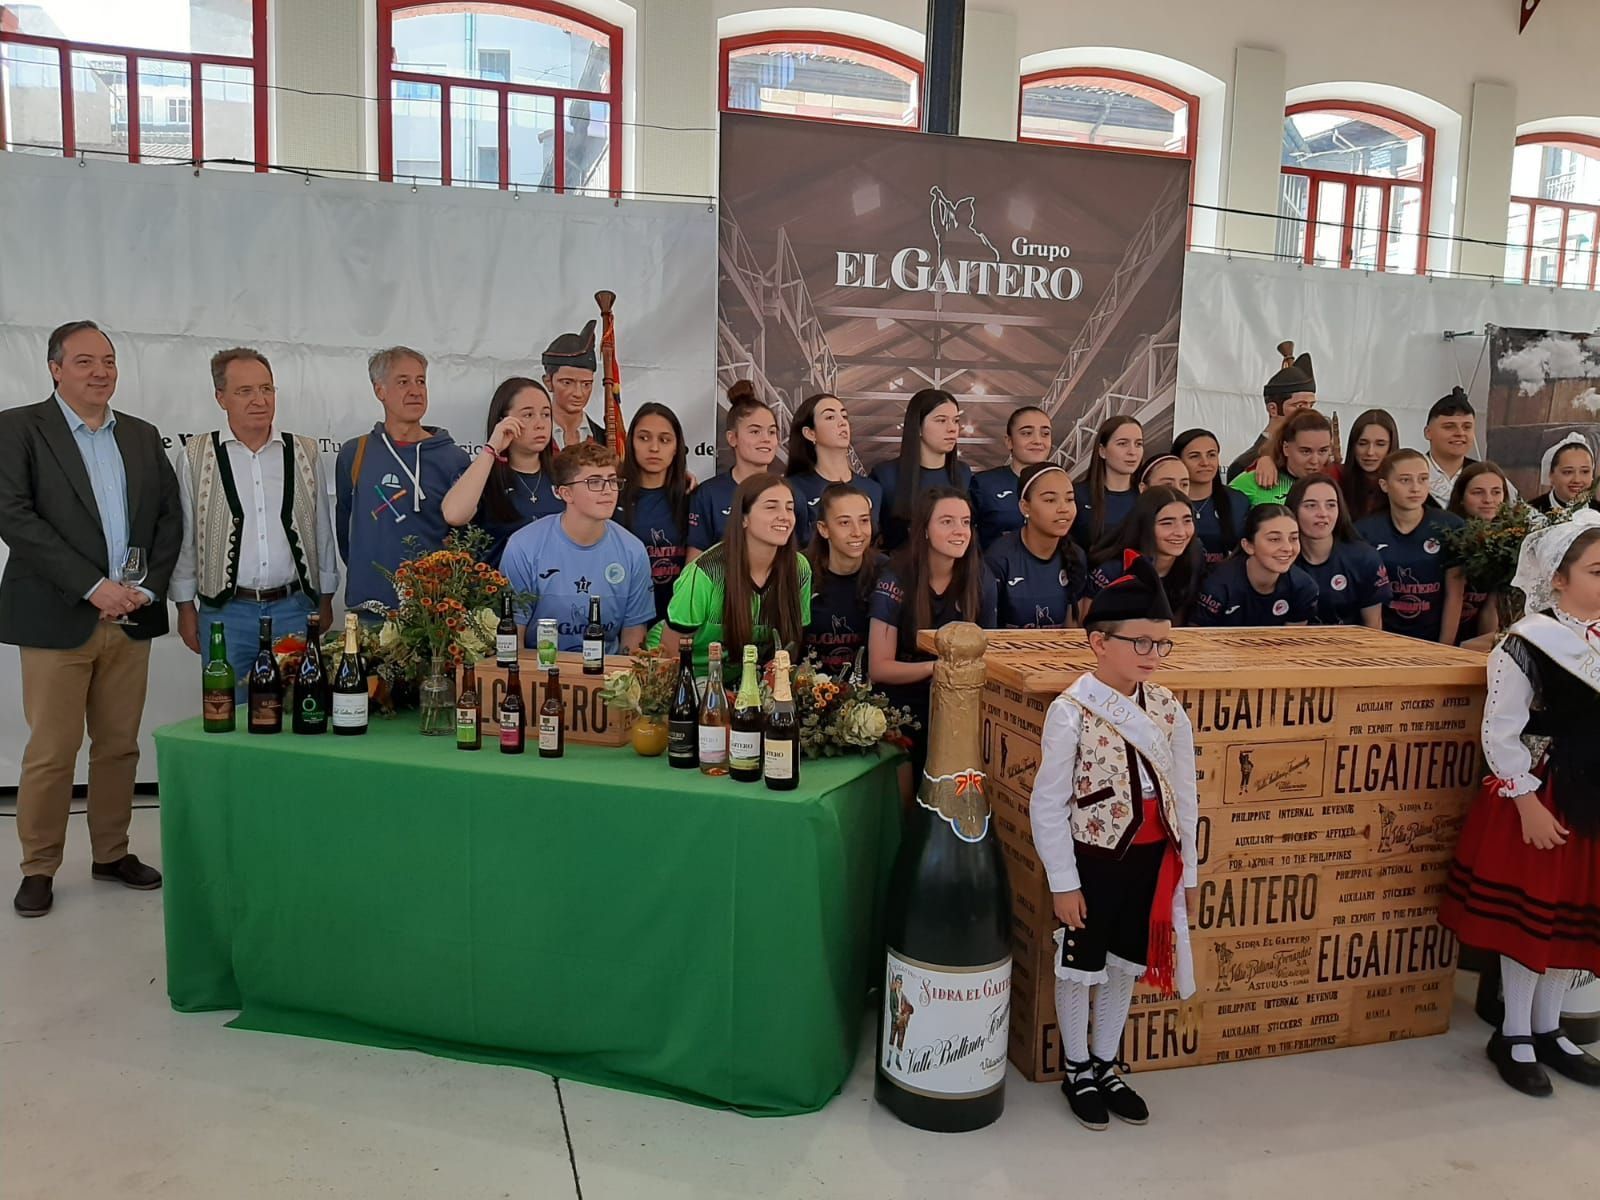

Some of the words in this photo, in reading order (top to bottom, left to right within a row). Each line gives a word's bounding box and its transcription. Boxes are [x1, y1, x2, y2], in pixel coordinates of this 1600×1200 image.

[1011, 237, 1071, 261] Grupo
[835, 251, 891, 289] EL
[891, 247, 1083, 301] GAITERO
[694, 442, 715, 456] de
[1099, 691, 1136, 726] Rey
[1400, 699, 1435, 711] STICKERS
[1349, 725, 1363, 736] FOR
[1367, 724, 1393, 735] EXPORT
[1399, 722, 1408, 732] TO
[1411, 721, 1423, 732] THE
[1334, 740, 1476, 794] ELGAITERO
[1231, 810, 1271, 822] PHILIPPINE
[1278, 807, 1314, 819] INTERNAL
[1235, 834, 1274, 847] AUXILIARY
[1281, 830, 1318, 843] STICKERS
[1325, 827, 1356, 839] AFFIXED
[1229, 859, 1242, 870] FOR
[1281, 855, 1290, 865] TO
[1308, 850, 1352, 863] PHILIPPINES
[1335, 868, 1373, 881] PHILIPPINE
[1189, 873, 1318, 931] GAITERO
[1339, 891, 1376, 903] AUXILIARY
[1382, 886, 1416, 899] STICKERS
[1333, 915, 1346, 926] FOR
[1350, 912, 1376, 924] EXPORT
[1382, 910, 1390, 921] TO
[1235, 939, 1260, 950] SIDRA
[1263, 937, 1273, 947] EL
[1275, 935, 1310, 946] GAITERO
[1317, 924, 1454, 983] ELGAITERO
[919, 979, 963, 1007] SIDRA
[966, 987, 981, 1001] EL
[1248, 980, 1289, 991] ASTURIAS
[1217, 1001, 1257, 1015] PHILIPPINE
[1264, 996, 1299, 1009] INTERNAL
[1222, 1024, 1260, 1038] AUXILIARY
[1268, 1018, 1302, 1032] STICKERS
[1310, 1013, 1340, 1026] AFFIXED
[1216, 1050, 1230, 1062] FOR
[1235, 1046, 1261, 1059] EXPORT
[1267, 1043, 1277, 1054] TO
[1280, 1041, 1294, 1052] THE
[1294, 1035, 1336, 1050] PHILIPPINES
[904, 1045, 934, 1075] Valle
